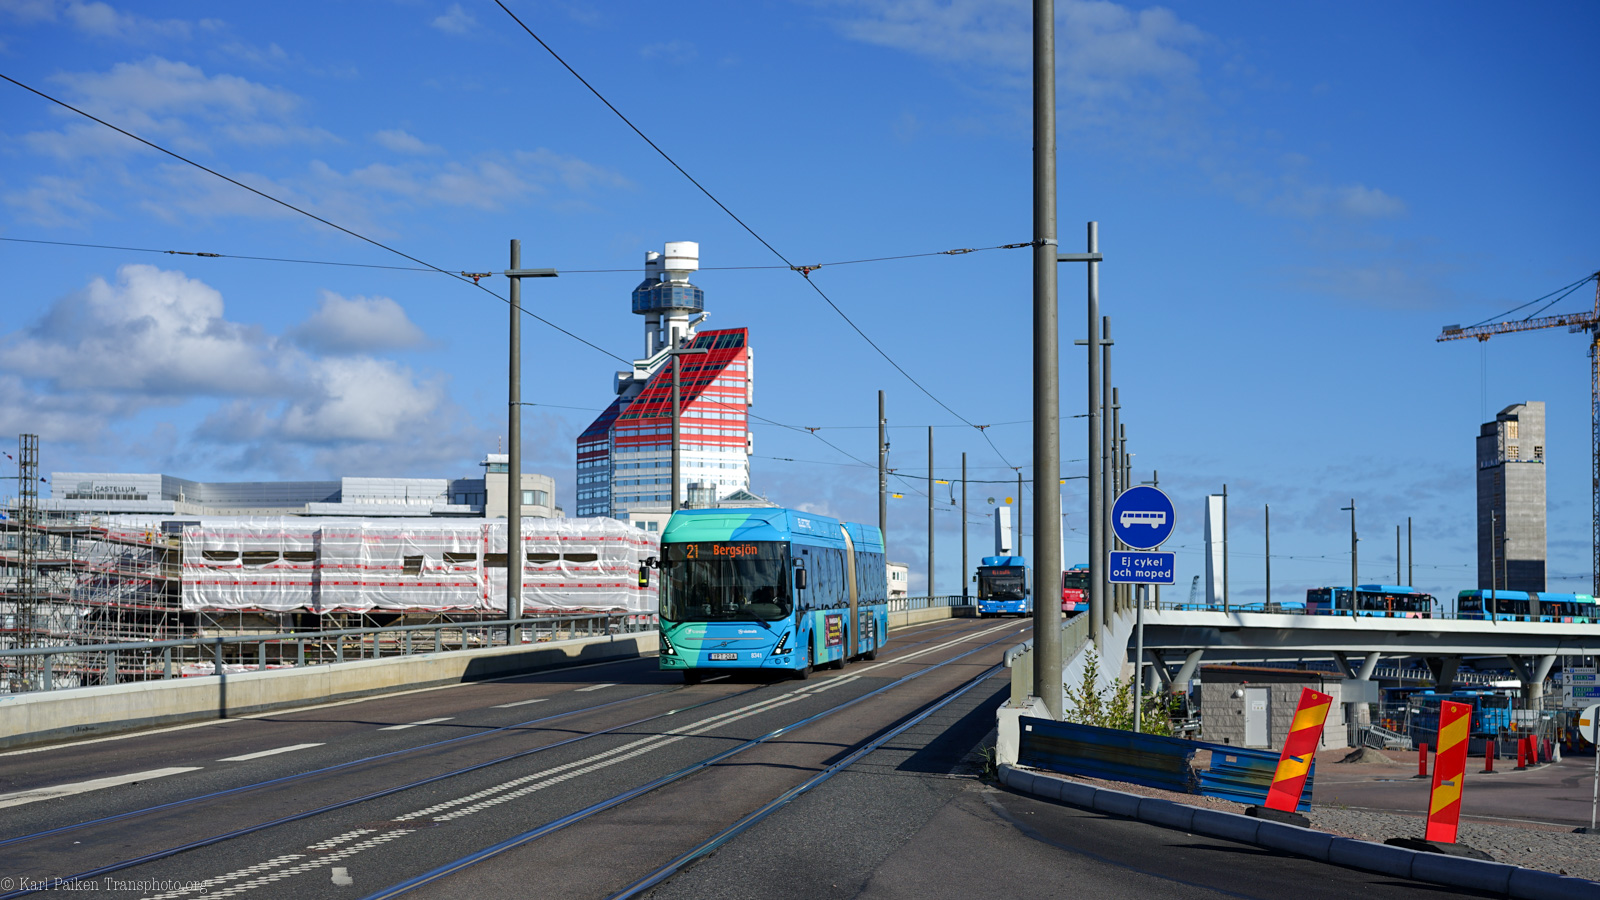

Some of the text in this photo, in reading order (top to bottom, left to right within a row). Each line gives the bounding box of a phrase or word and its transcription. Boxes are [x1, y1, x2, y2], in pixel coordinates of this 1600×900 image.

[686, 544, 758, 558] 21 Bergsjön
[1122, 556, 1163, 568] Ej cykel
[1113, 568, 1171, 580] och moped
